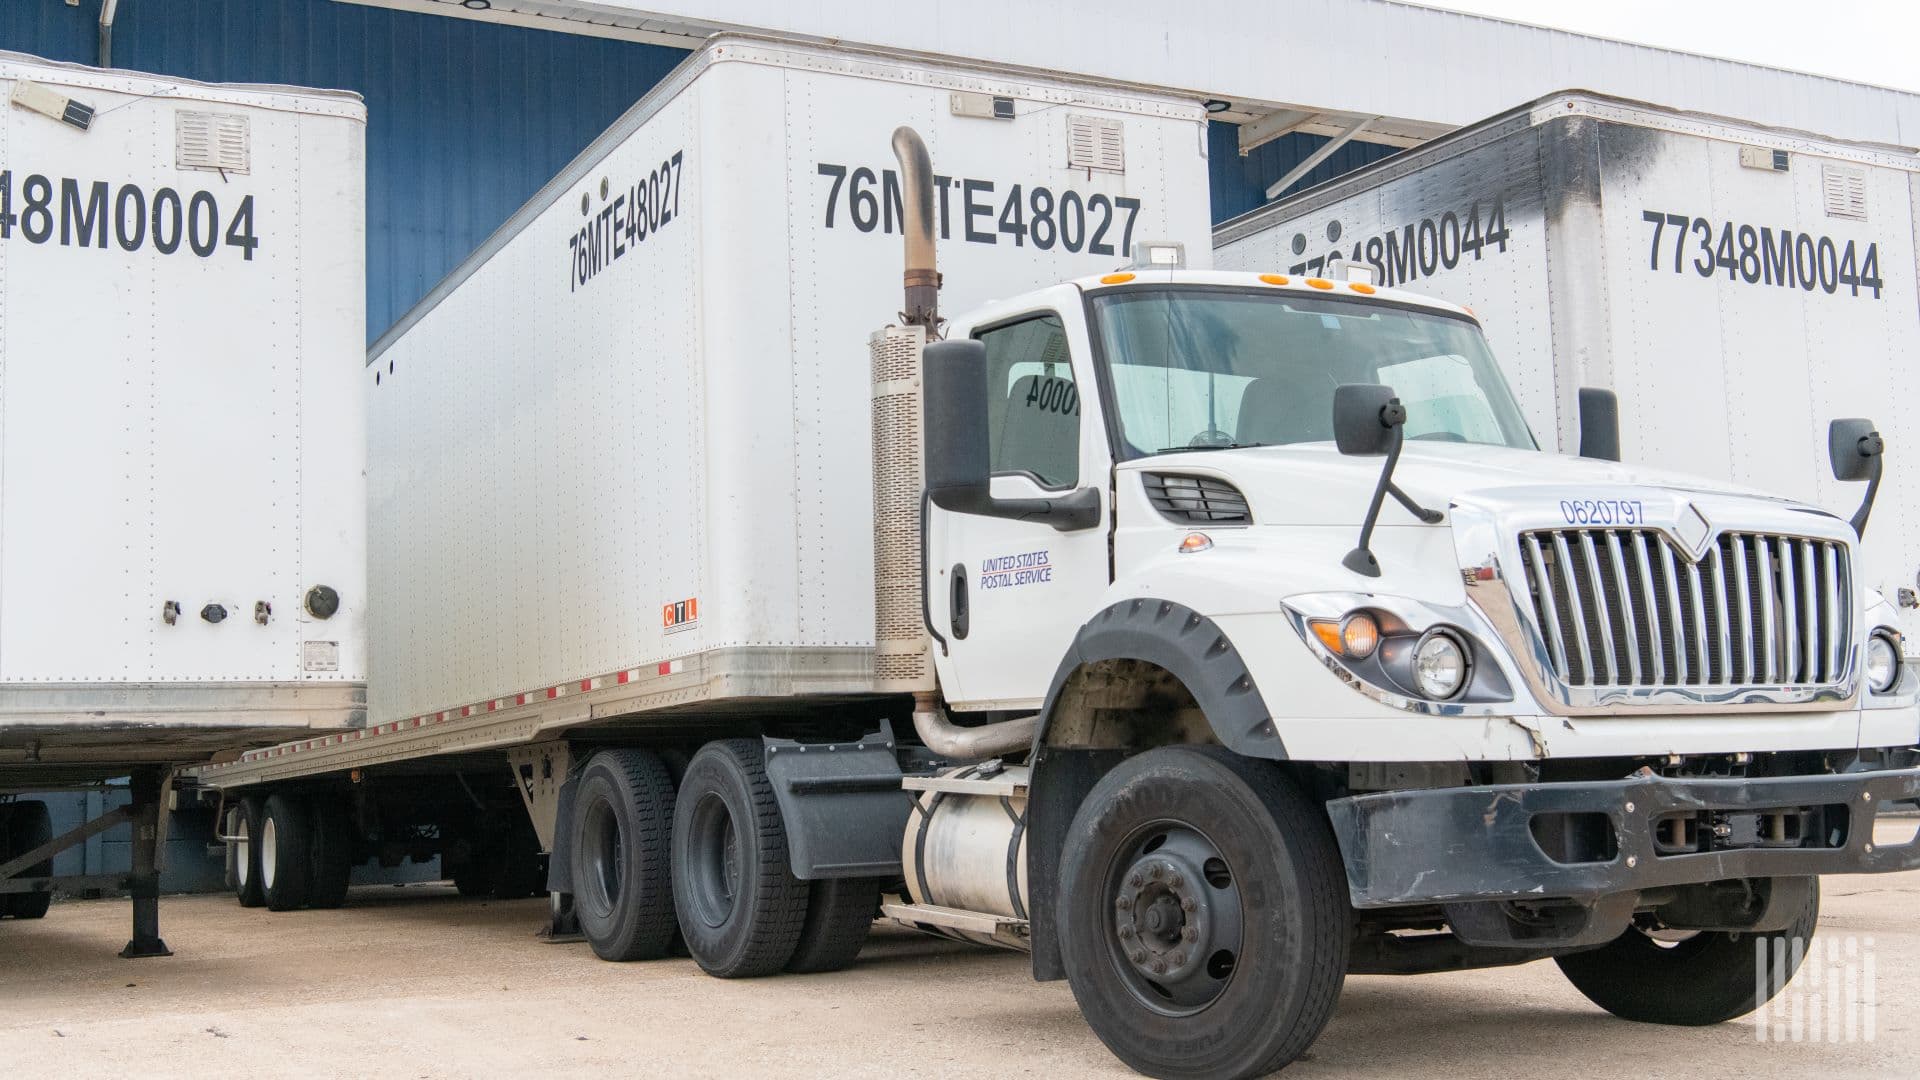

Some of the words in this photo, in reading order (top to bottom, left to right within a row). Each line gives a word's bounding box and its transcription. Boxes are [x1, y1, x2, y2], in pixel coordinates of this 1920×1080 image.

[570, 149, 683, 293] 76MTE48027
[1289, 190, 1510, 288] 8M0044
[1642, 209, 1884, 300] 77348M0044
[1560, 500, 1643, 525] 0620797
[982, 556, 1016, 573] UNITED
[1016, 551, 1049, 569] STATES
[980, 573, 1013, 590] POSTAL
[1014, 567, 1052, 586] SERVICE
[664, 599, 697, 627] CTL
